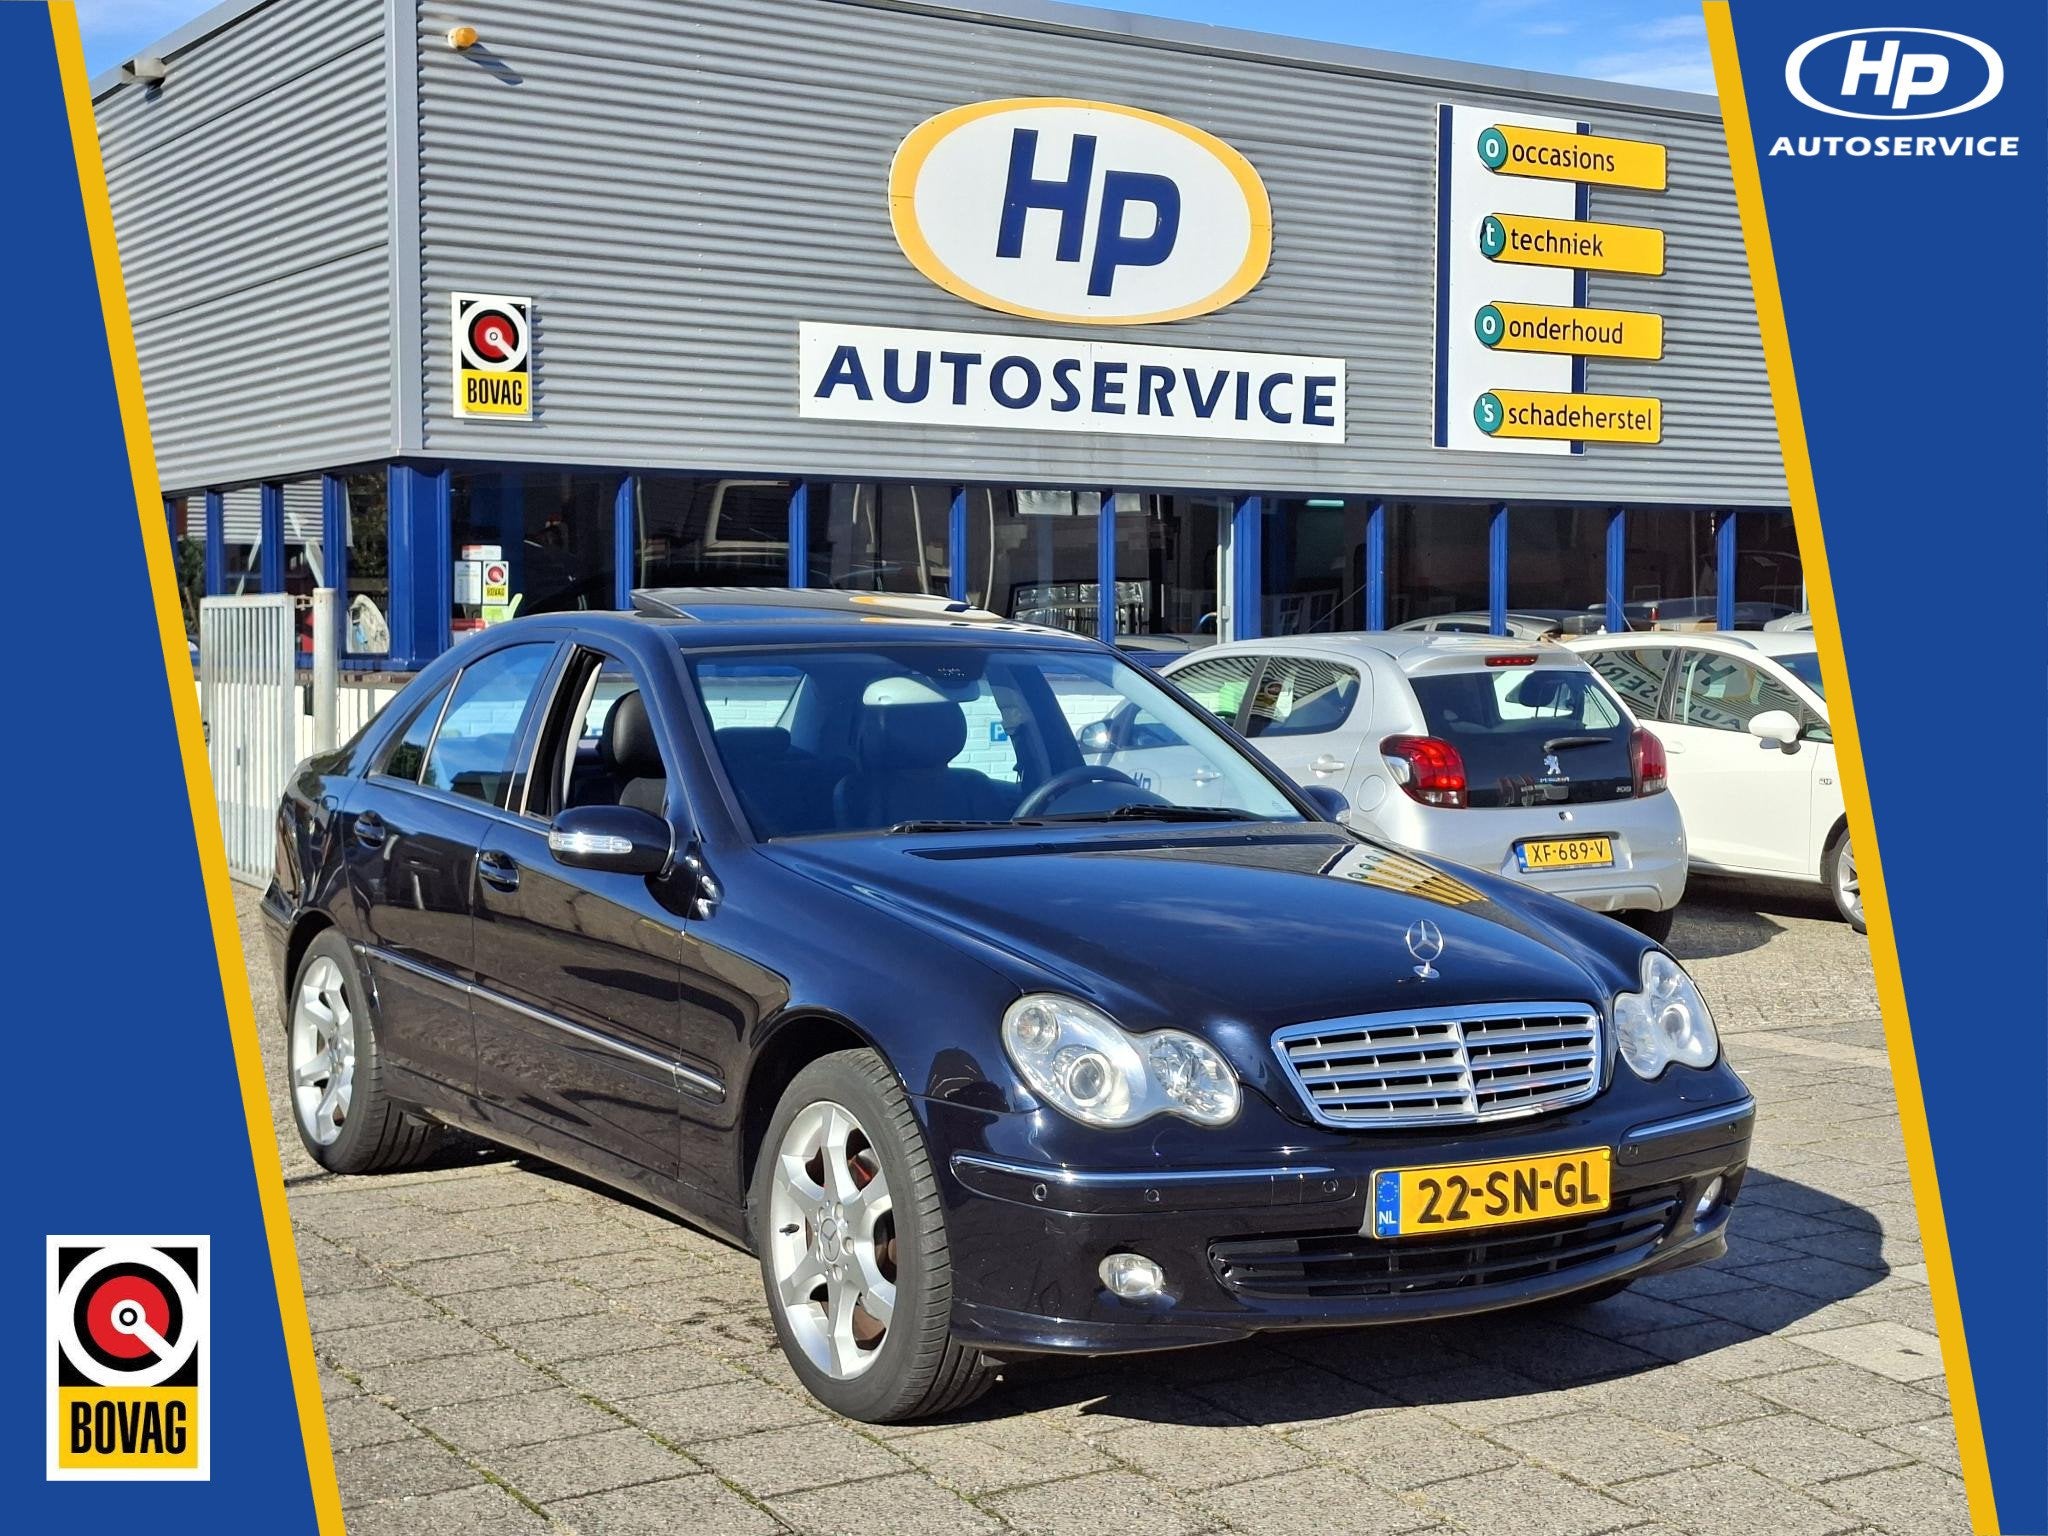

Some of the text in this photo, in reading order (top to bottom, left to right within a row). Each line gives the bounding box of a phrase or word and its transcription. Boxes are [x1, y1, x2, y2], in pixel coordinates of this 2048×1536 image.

[1511, 143, 1616, 172] occasions
[1510, 228, 1604, 257] techniek
[1509, 316, 1624, 345] onderhoud
[467, 377, 522, 406] BOVAG
[814, 345, 1337, 427] AUTOSERVICE
[1508, 403, 1652, 431] schadeherstel
[1531, 840, 1604, 862] XF-689-V
[1378, 1160, 1600, 1225] NL 22-SN-GL
